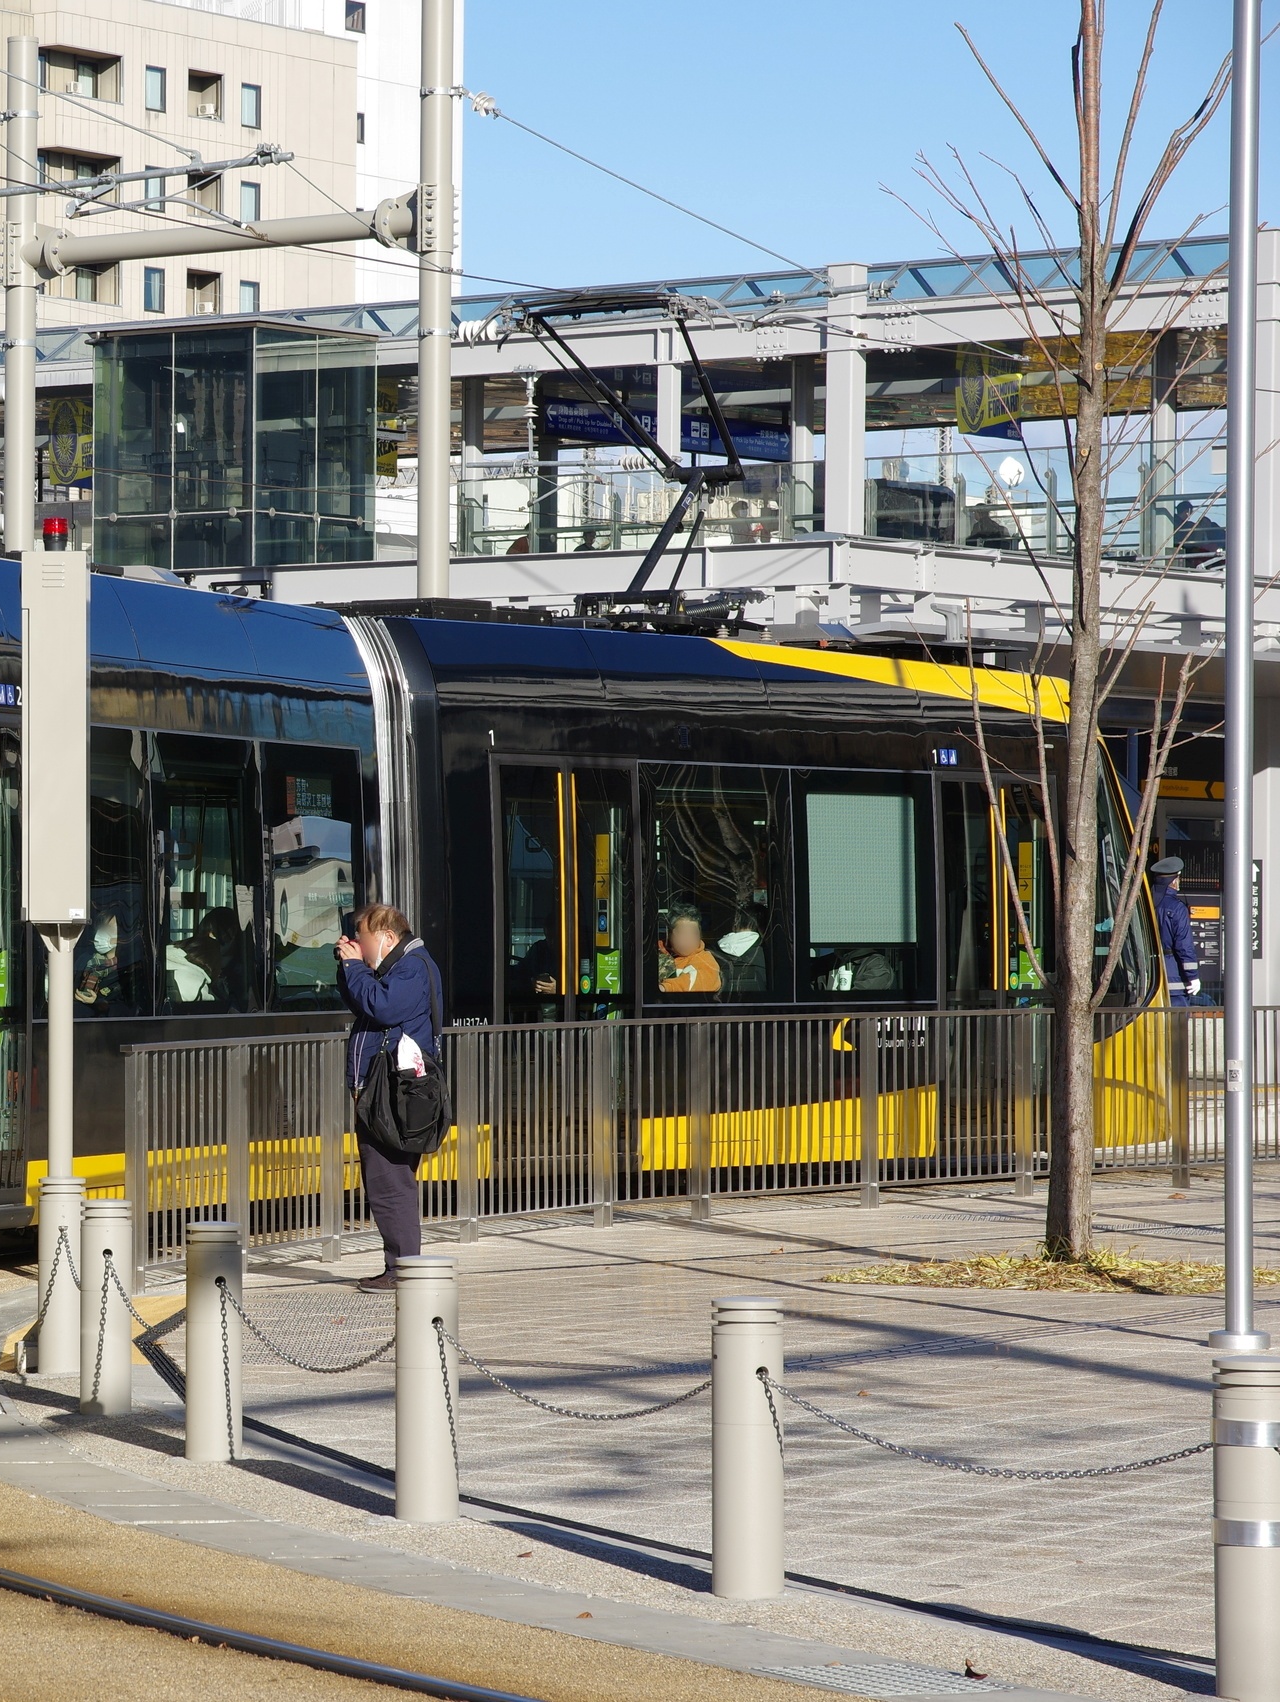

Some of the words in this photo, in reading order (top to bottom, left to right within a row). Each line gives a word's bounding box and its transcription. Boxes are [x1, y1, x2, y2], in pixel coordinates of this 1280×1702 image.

[596, 420, 613, 428] Disabled
[16, 686, 22, 705] 2
[488, 729, 494, 746] 1
[932, 749, 937, 764] 1
